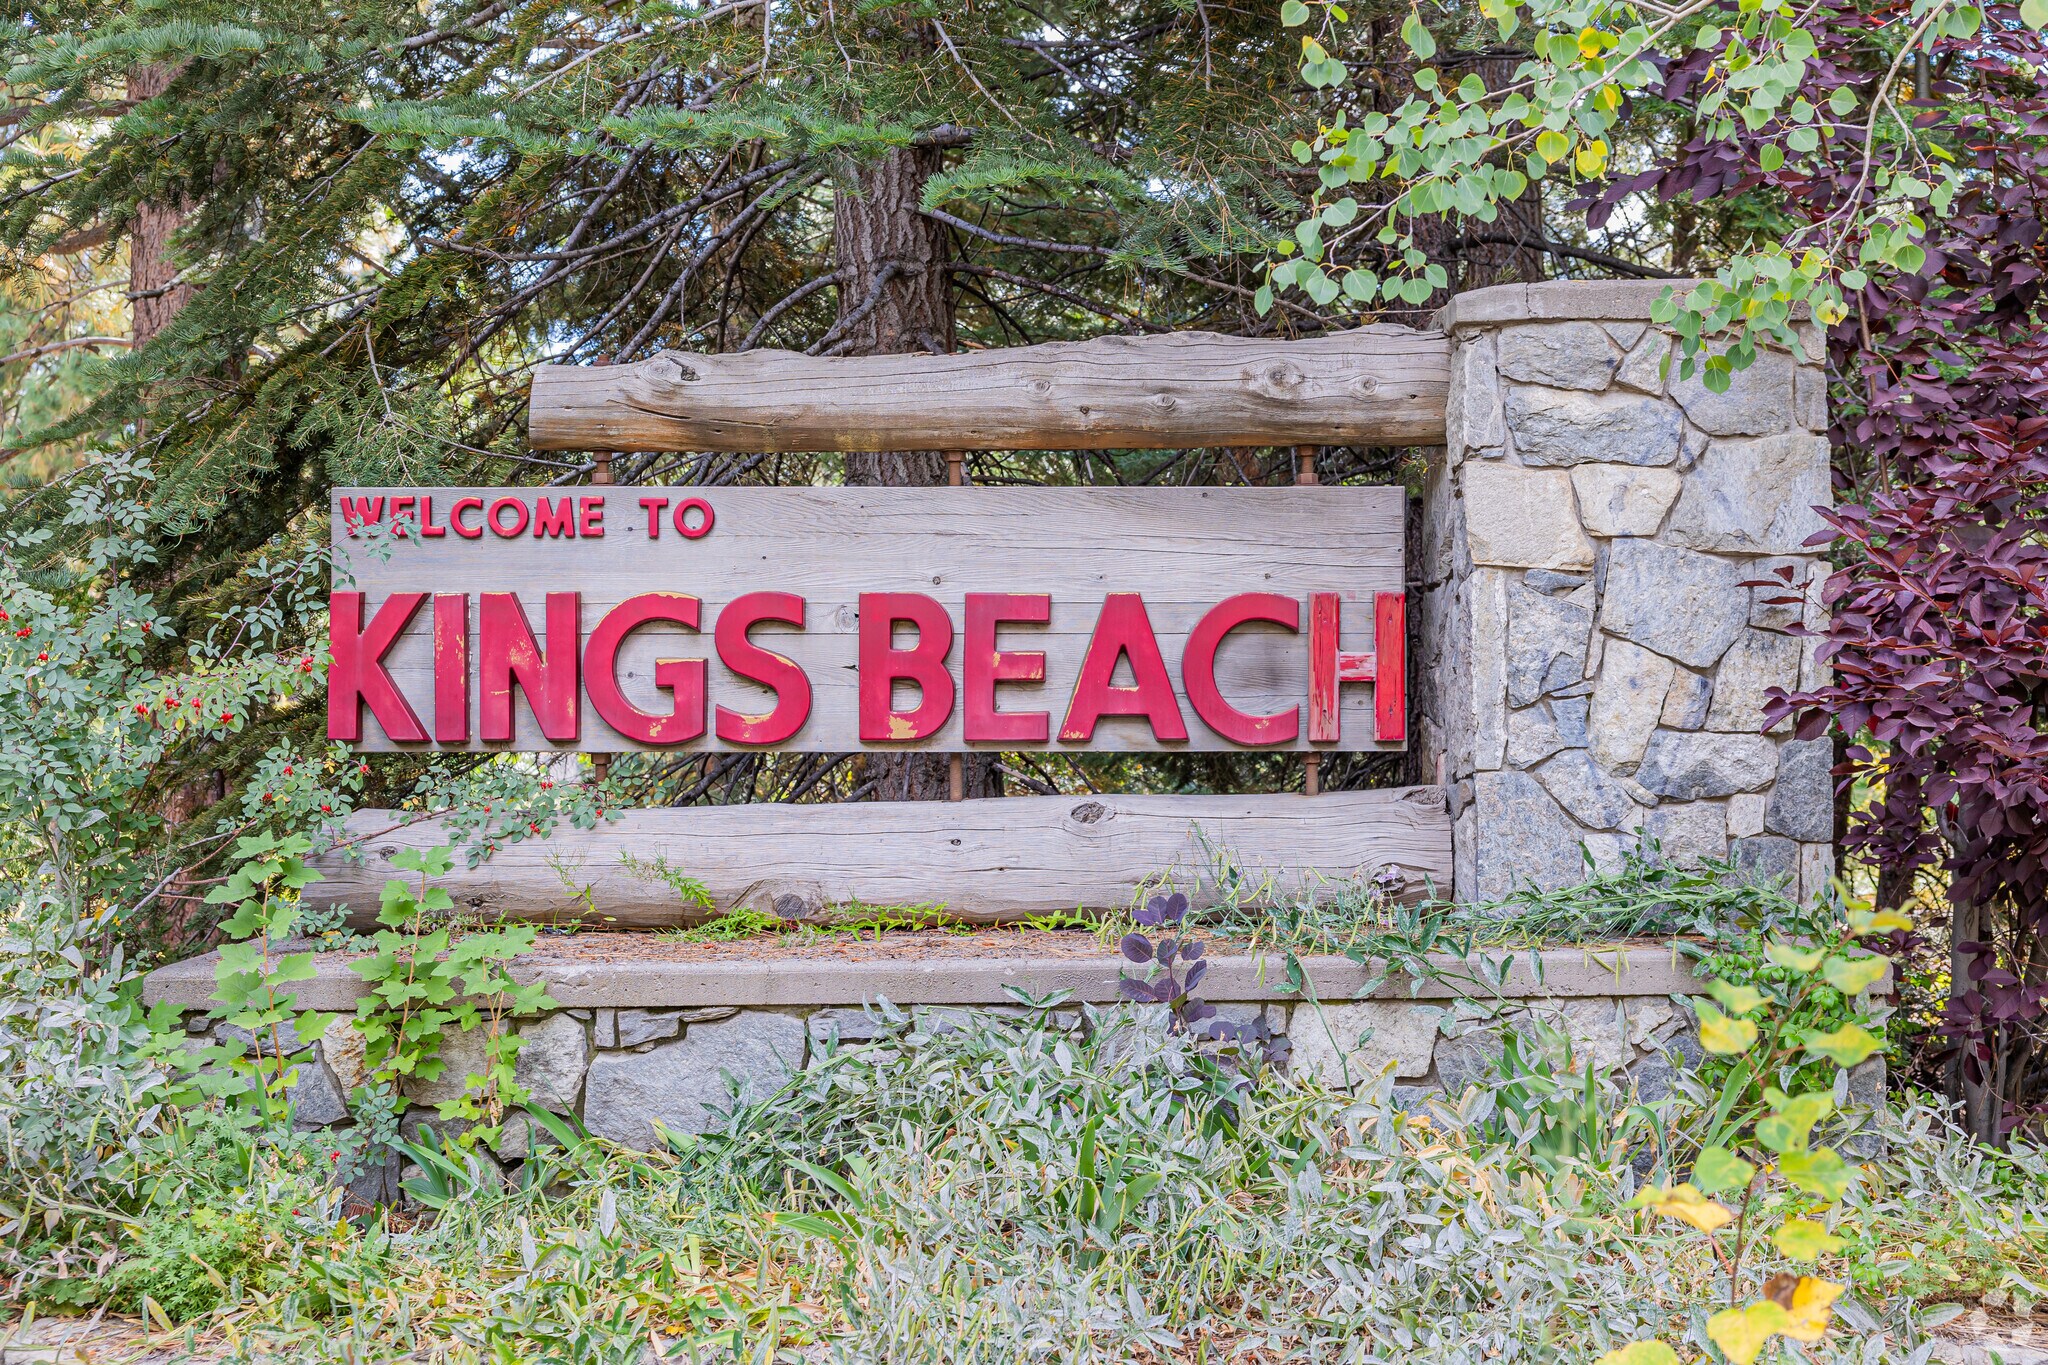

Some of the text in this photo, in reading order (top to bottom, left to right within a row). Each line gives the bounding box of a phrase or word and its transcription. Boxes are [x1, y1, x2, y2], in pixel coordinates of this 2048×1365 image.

[339, 495, 715, 540] WELCOME TO
[327, 591, 1406, 746] KINGS BEACH
